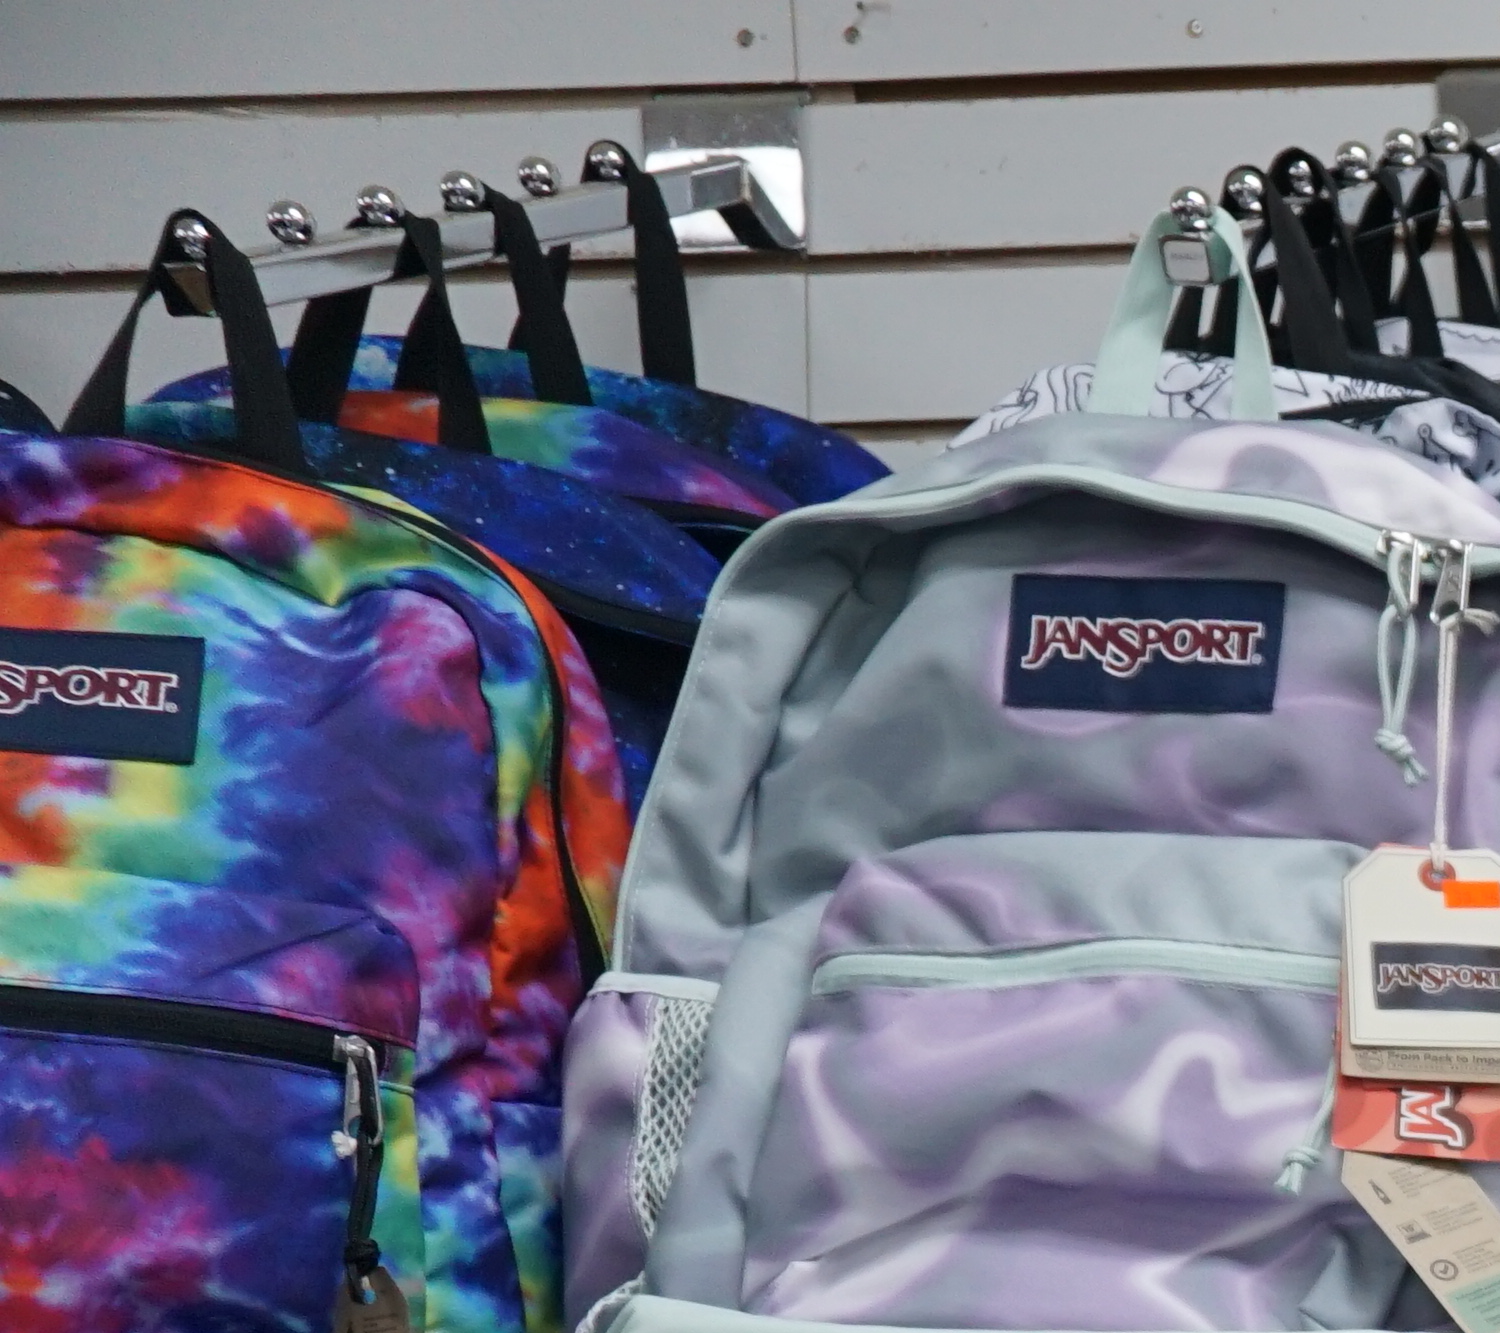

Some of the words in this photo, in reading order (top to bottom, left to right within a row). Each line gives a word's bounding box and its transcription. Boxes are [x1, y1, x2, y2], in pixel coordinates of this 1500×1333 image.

[1021, 614, 1264, 678] JANSPORT
[0, 660, 179, 715] SPORT
[1456, 1054, 1469, 1064] to
